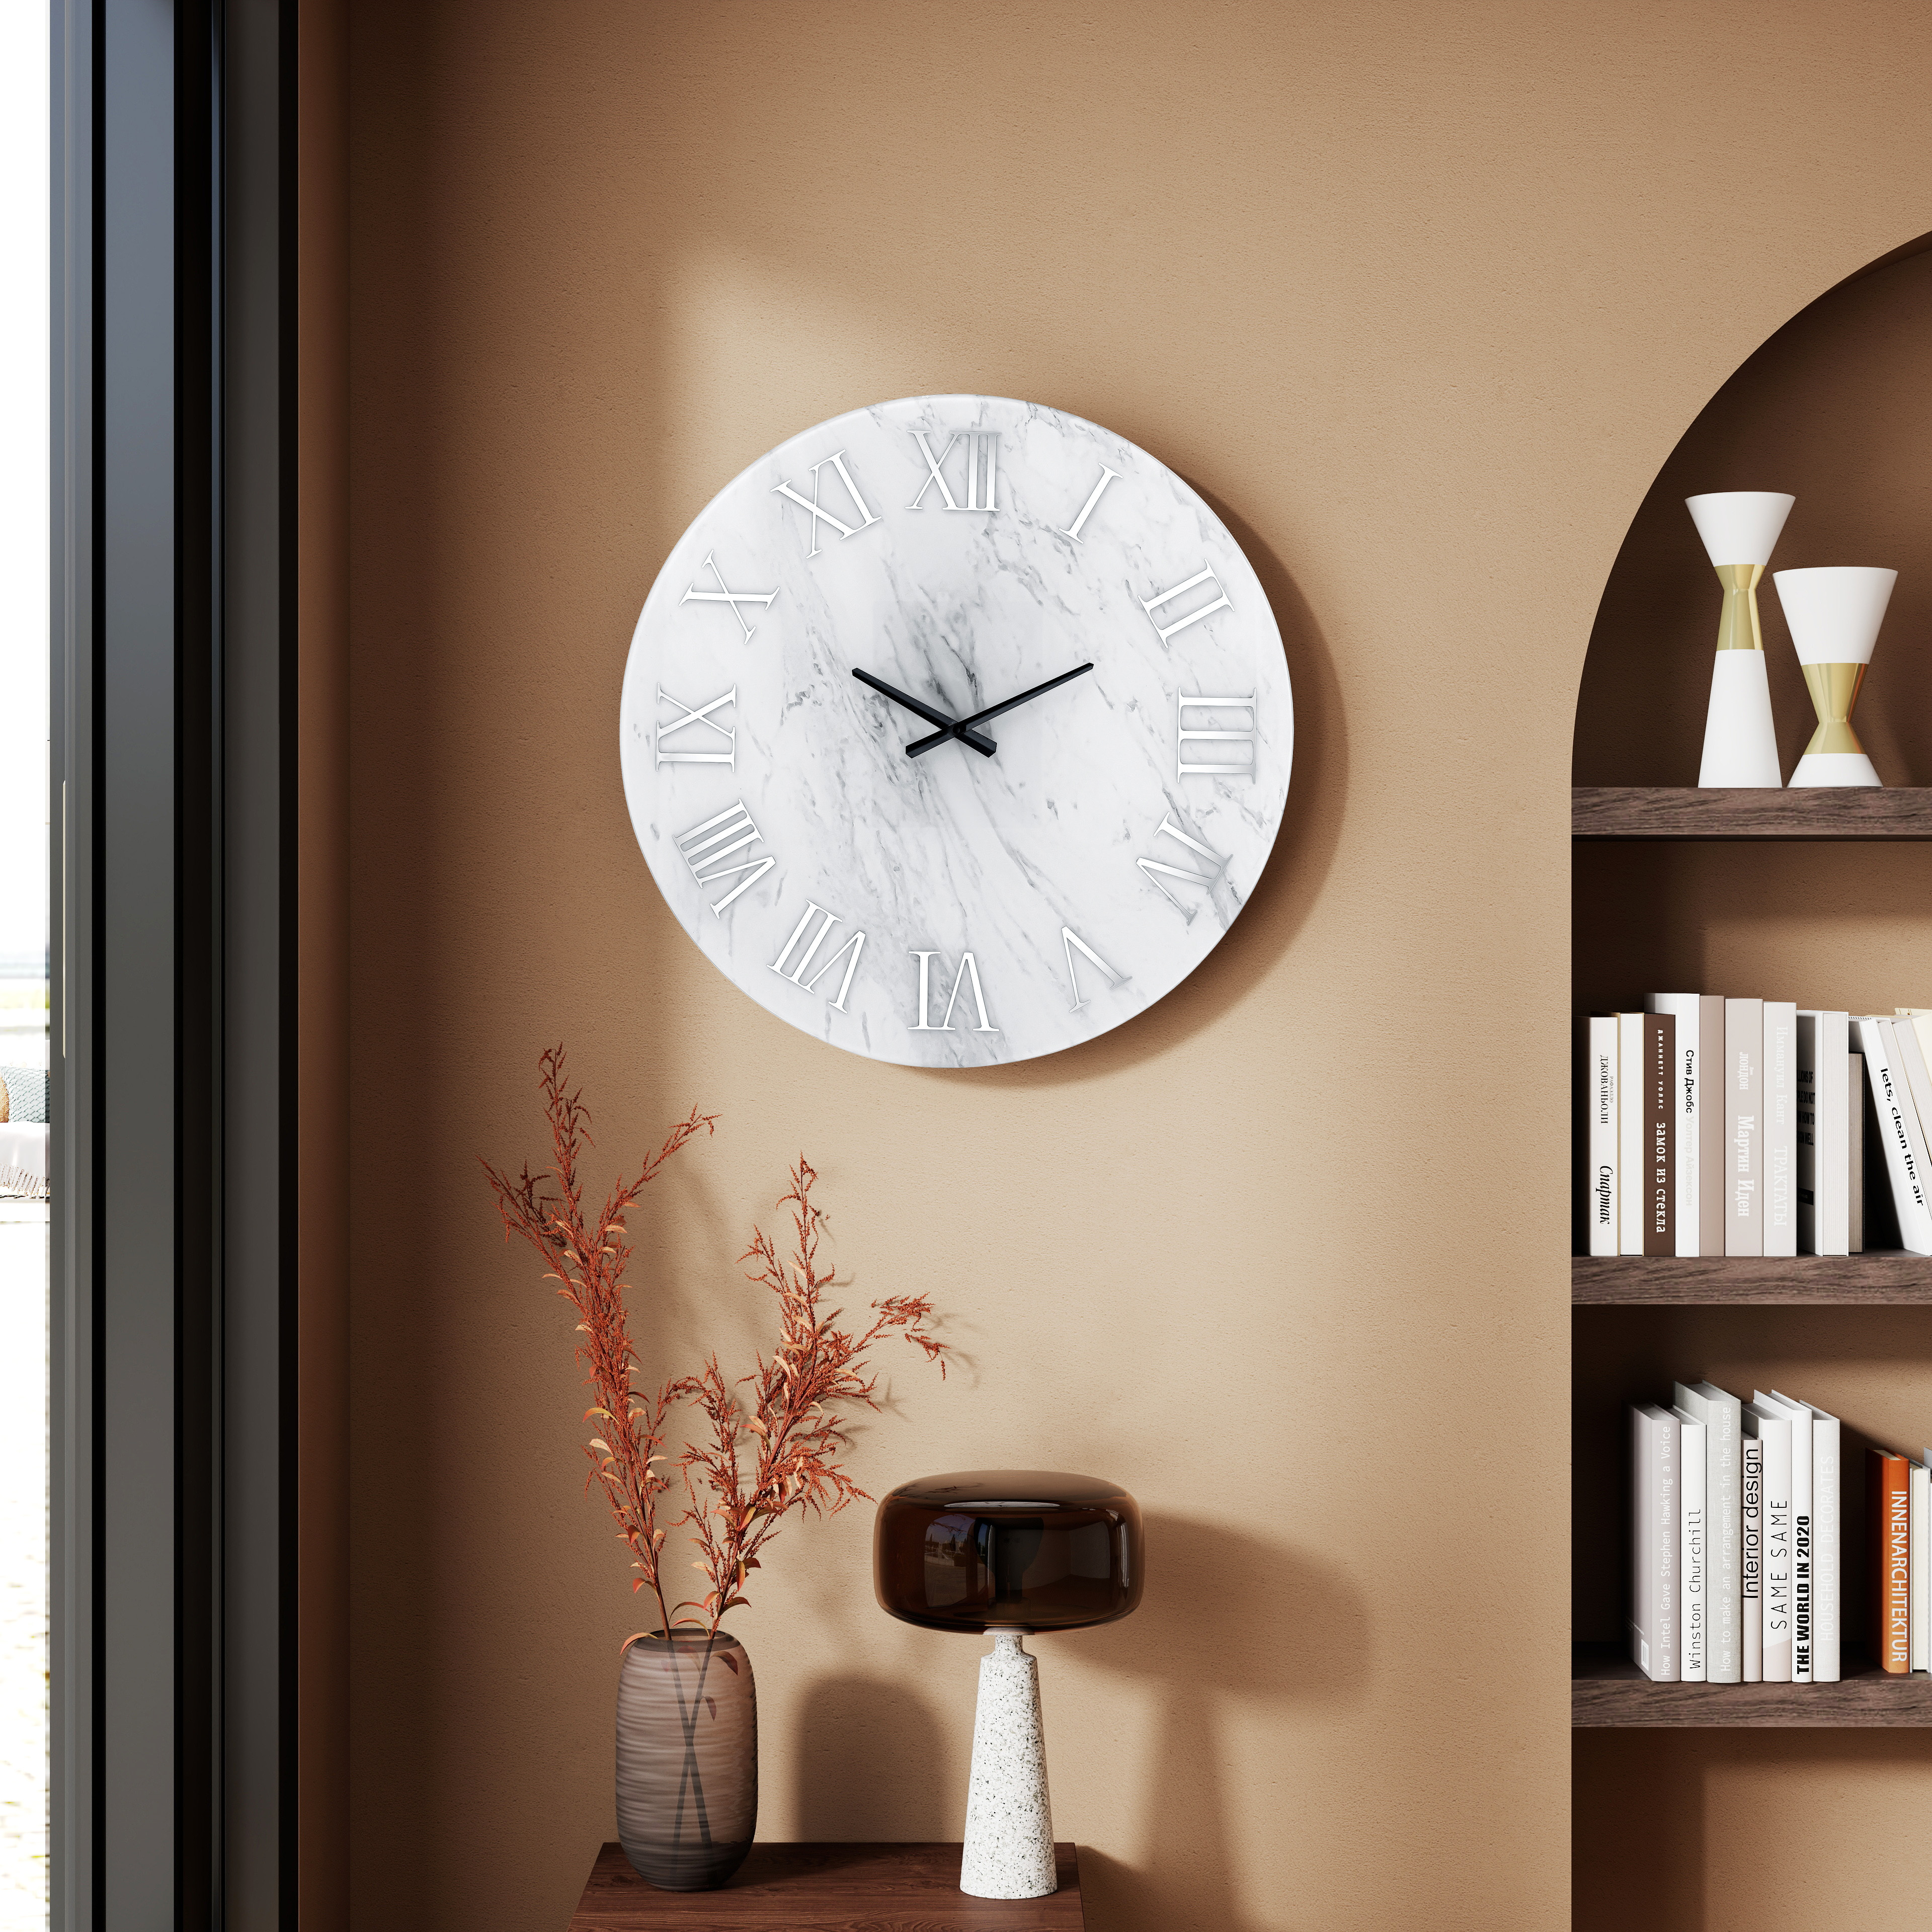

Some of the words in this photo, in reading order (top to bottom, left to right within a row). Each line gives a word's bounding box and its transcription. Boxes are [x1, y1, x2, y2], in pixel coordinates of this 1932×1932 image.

[905, 430, 1002, 512] XII
[770, 449, 881, 559] XI
[1058, 462, 1123, 544] I
[678, 548, 781, 645] X
[1138, 557, 1235, 650] II
[655, 682, 738, 773] IX
[1176, 687, 1258, 784] III
[672, 797, 777, 920] VIII
[1135, 811, 1233, 926] IV
[766, 899, 866, 1015] VII
[1061, 925, 1133, 1013] V
[907, 950, 1000, 1032] VI
[1774, 1026, 1788, 1088] Иммануил
[1809, 1071, 1813, 1084] OF
[1600, 1055, 1608, 1123] ДЖОВАНЬОЛИ
[1684, 1078, 1694, 1113] Джобс
[1777, 1094, 1787, 1124] Кант
[1804, 1091, 1808, 1104] DO
[1684, 1116, 1694, 1153] Уолтер
[1734, 1115, 1754, 1172] Мартин
[1805, 1132, 1814, 1146] WELL
[1810, 1112, 1815, 1125] TO
[1881, 1068, 1893, 1102] lets,
[1891, 1106, 1907, 1149] clean
[1904, 1153, 1916, 1181] the
[1912, 1184, 1924, 1206] air
[1596, 1166, 1613, 1224] Спартак
[1686, 1156, 1694, 1205] Айзексон
[1735, 1179, 1754, 1217] Иден
[1774, 1146, 1787, 1226] ТРАКТАТЫ
[1660, 1427, 1670, 1459] Voice
[1720, 1407, 1731, 1440] house
[1720, 1448, 1730, 1467] the
[1720, 1475, 1730, 1487] in
[1741, 1450, 1761, 1517] design
[1660, 1479, 1672, 1524] Hawking
[1821, 1457, 1833, 1542] DECORATES
[1660, 1532, 1672, 1576] Stephen
[1689, 1509, 1700, 1592] Churchill
[1721, 1495, 1733, 1569] arrangement
[1771, 1501, 1787, 1557] SAME
[1797, 1516, 1809, 1557] 2020
[1723, 1577, 1730, 1589] an
[1742, 1525, 1758, 1598] Interior
[1797, 1563, 1809, 1578] IN
[1892, 1491, 1907, 1661] INNENARCHITEKTUR
[1661, 1584, 1670, 1609] Gave
[1720, 1597, 1730, 1624] make
[1771, 1573, 1787, 1629] SAME
[1797, 1583, 1809, 1641] WORLD
[1821, 1554, 1833, 1640] HOUSEHOLD
[1660, 1617, 1670, 1648] Intel
[1689, 1604, 1700, 1668] Winston
[1721, 1631, 1730, 1643] to
[1797, 1646, 1809, 1674] THE
[1661, 1655, 1670, 1675] How
[1721, 1651, 1730, 1671] How
